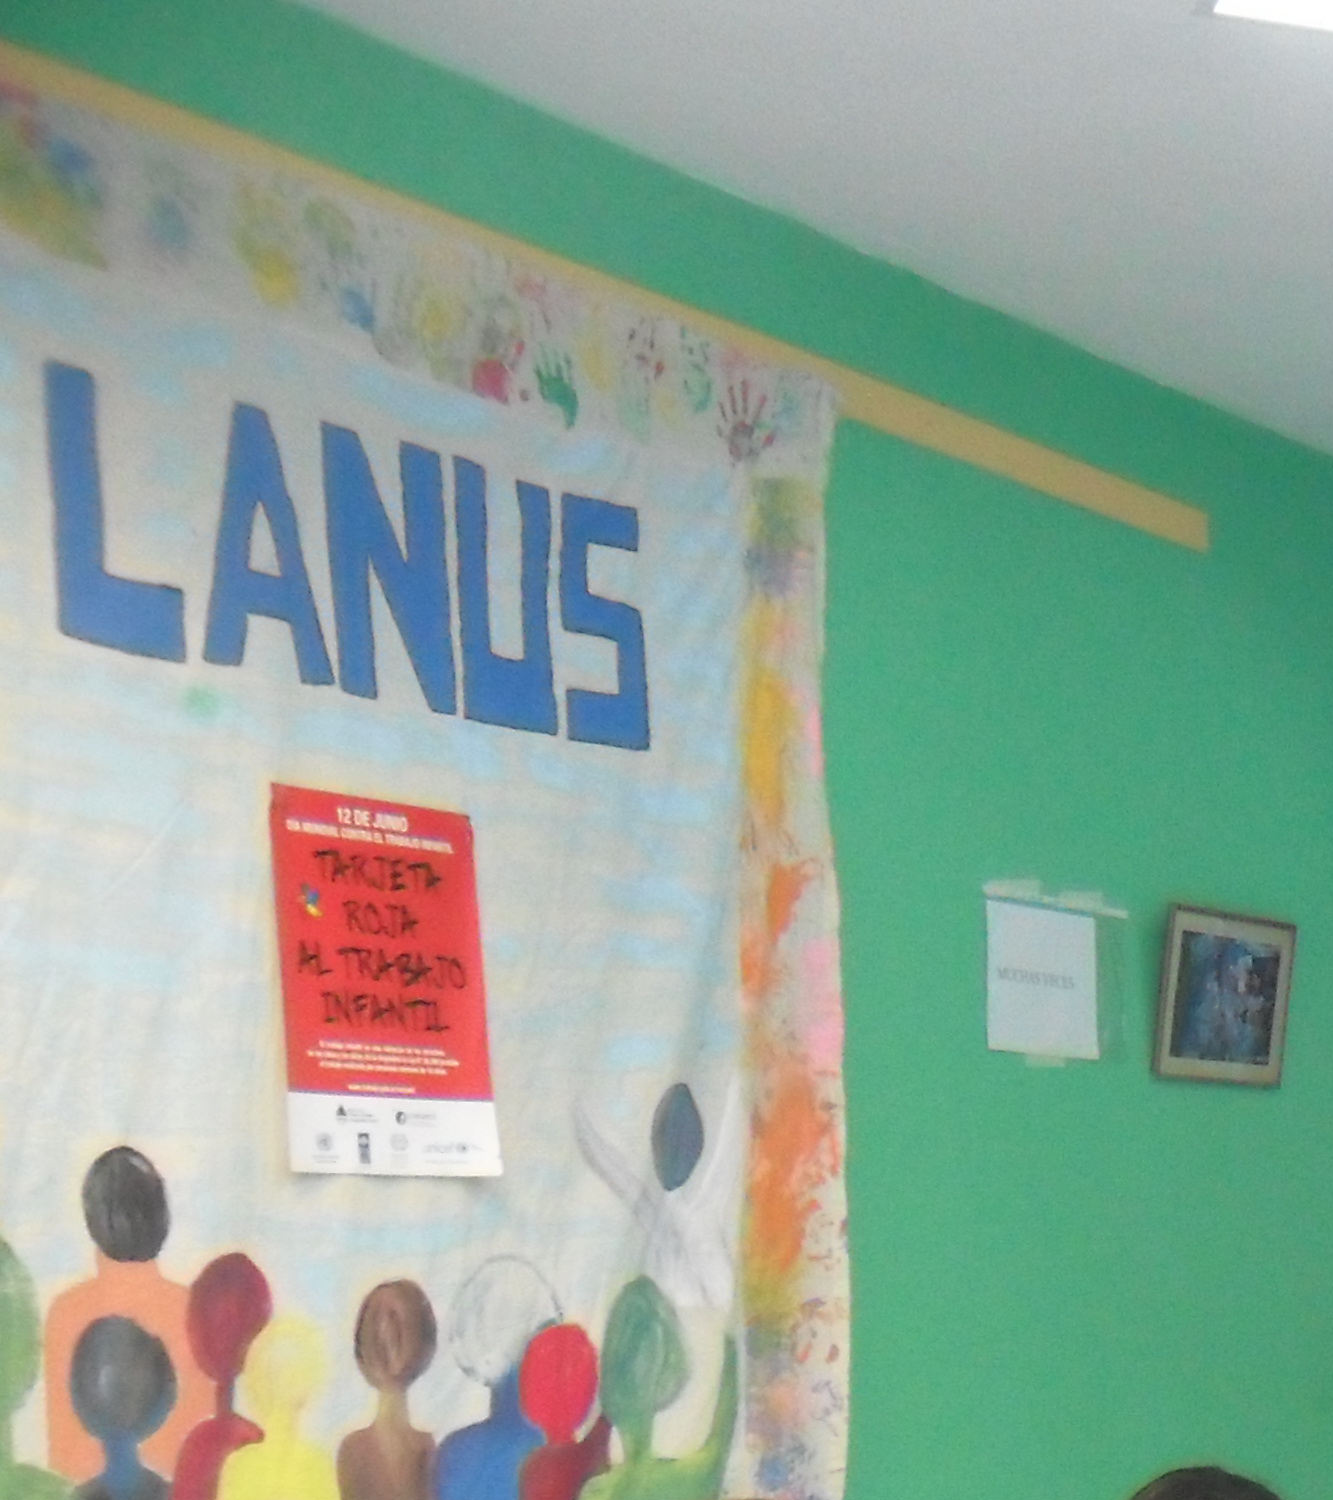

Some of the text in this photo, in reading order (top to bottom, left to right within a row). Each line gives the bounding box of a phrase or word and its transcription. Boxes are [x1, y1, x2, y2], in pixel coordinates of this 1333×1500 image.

[44, 359, 650, 751] LANUS
[337, 806, 409, 833] 12 DE JUNIO
[314, 850, 442, 891] TARJETA
[342, 900, 419, 939] ROJA
[298, 940, 467, 989] AL TRABAJO
[321, 990, 452, 1033] INFANTIL
